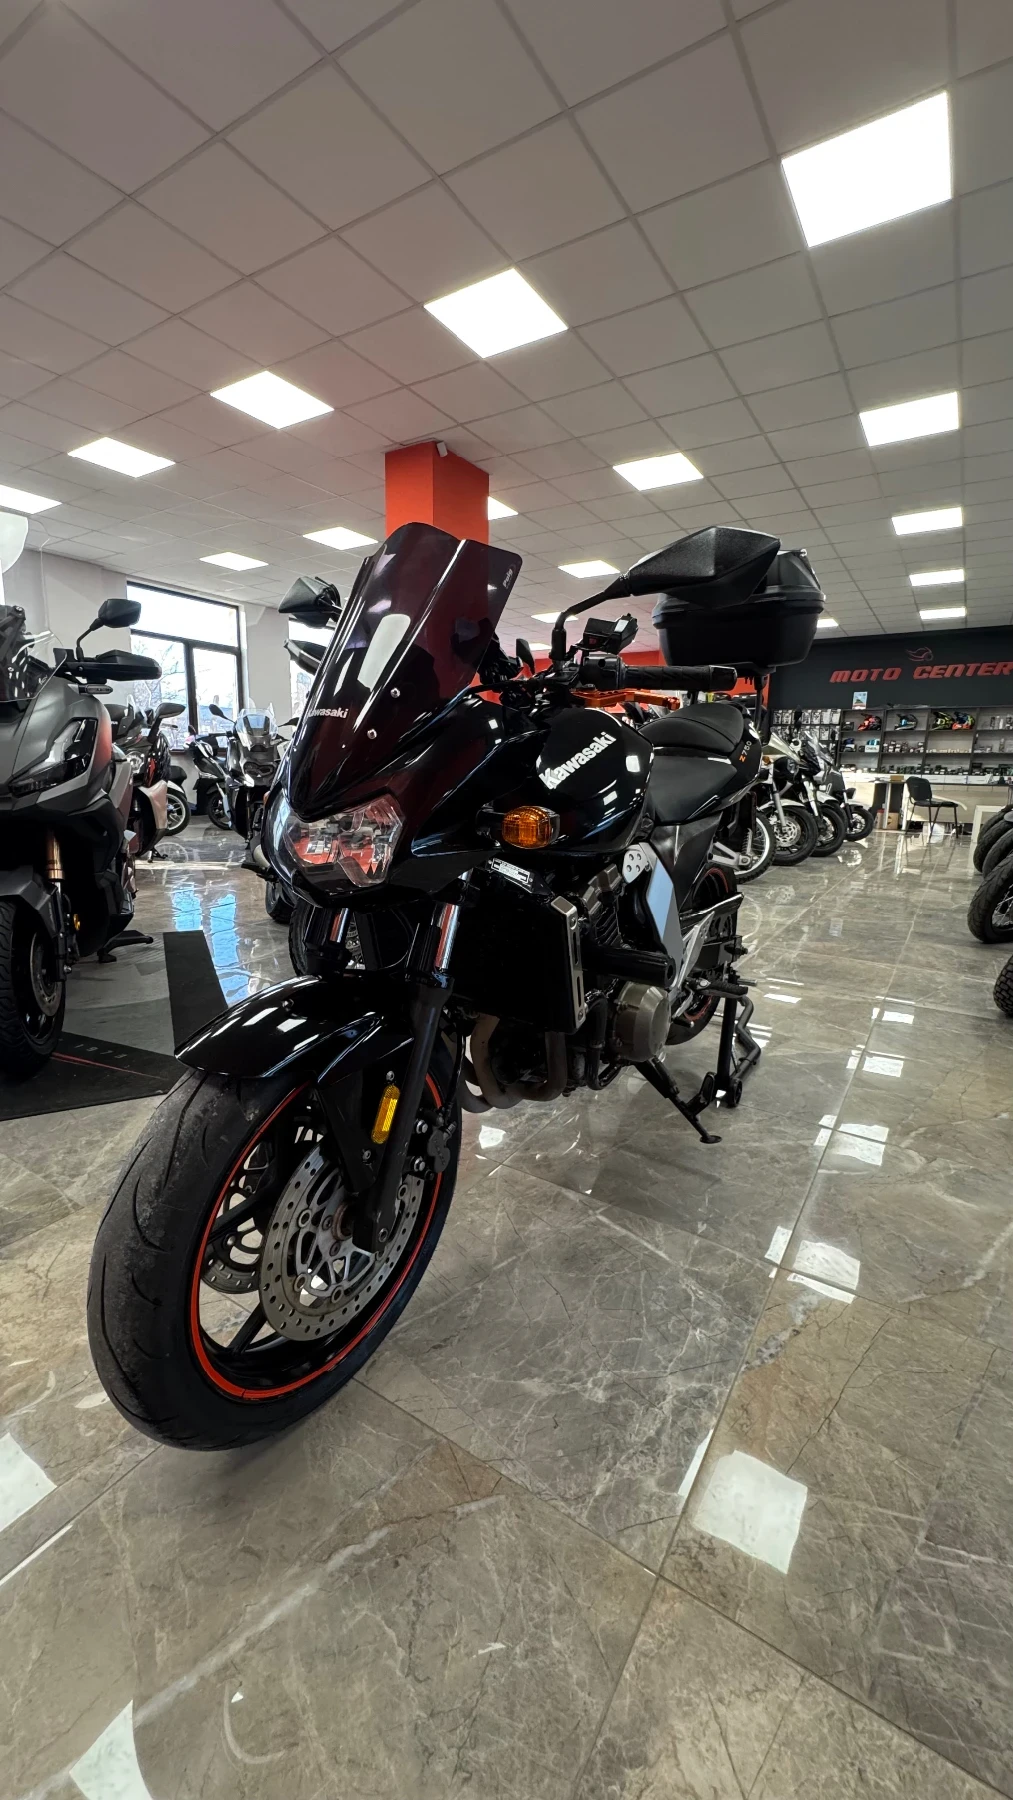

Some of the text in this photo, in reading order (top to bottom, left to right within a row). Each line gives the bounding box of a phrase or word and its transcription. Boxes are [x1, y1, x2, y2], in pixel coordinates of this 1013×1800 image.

[829, 661, 1013, 683] MOTO CENTER
[308, 707, 349, 719] wasaki
[538, 731, 617, 790] Kawasaki
